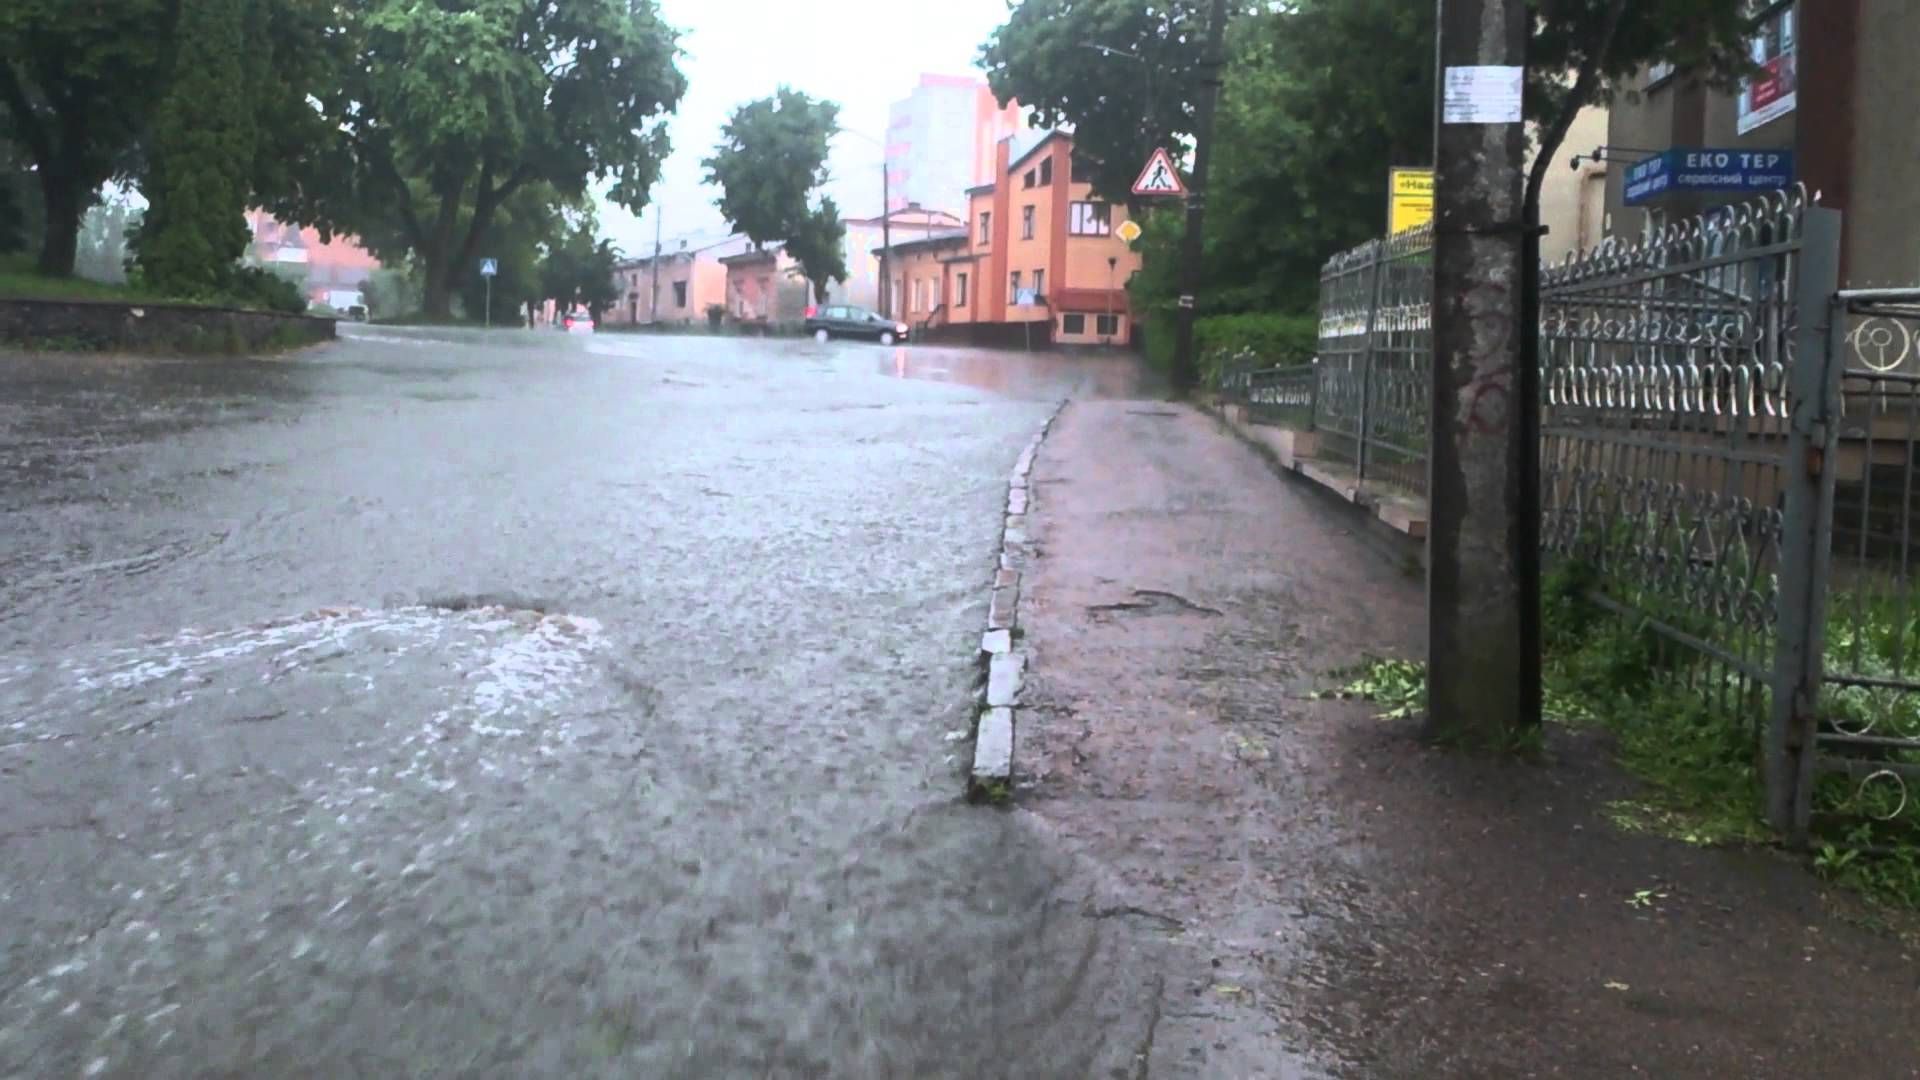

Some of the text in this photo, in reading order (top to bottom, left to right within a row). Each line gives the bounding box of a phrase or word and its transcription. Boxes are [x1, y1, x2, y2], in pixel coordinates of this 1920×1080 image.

[1686, 153, 1779, 169] ЕКО ТЕР
[1748, 174, 1787, 187] центр
